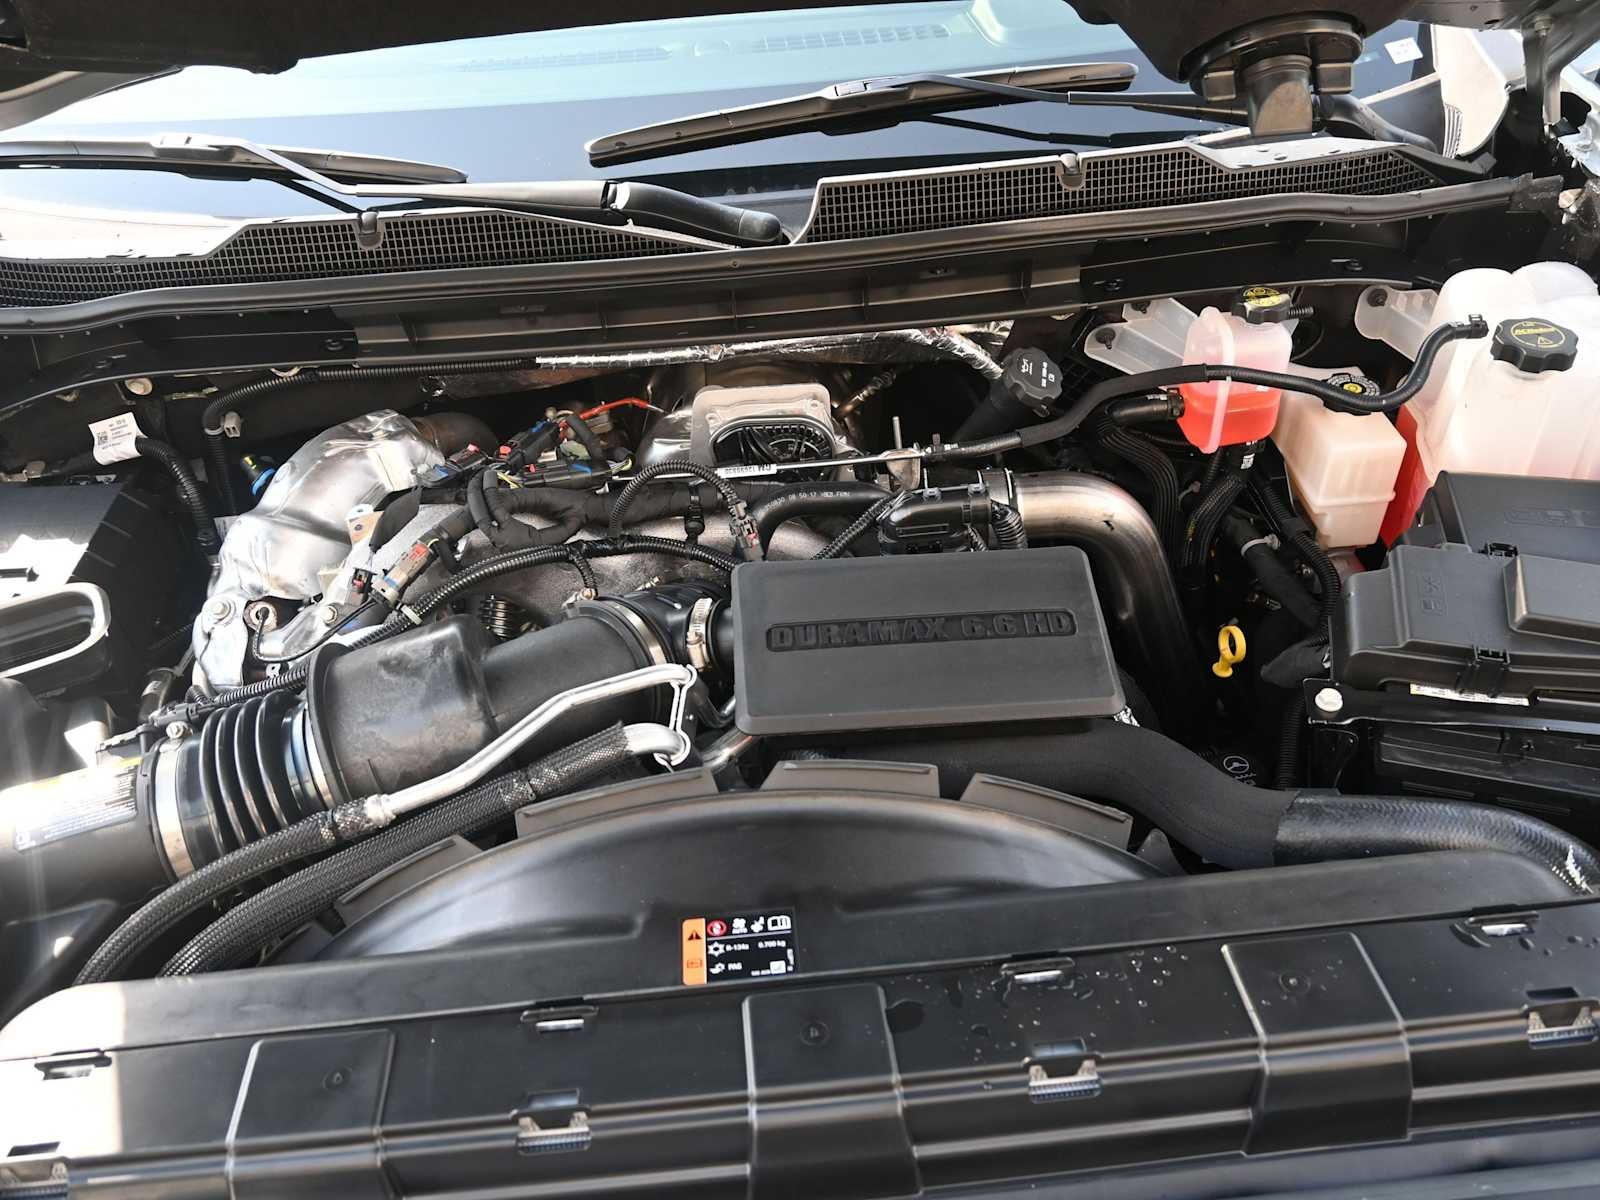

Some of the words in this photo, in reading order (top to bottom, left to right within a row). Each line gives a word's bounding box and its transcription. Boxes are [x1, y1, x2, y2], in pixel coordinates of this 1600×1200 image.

[771, 617, 950, 650] DURAMAX
[960, 614, 1018, 638] 6.6
[1023, 611, 1072, 636] HD
